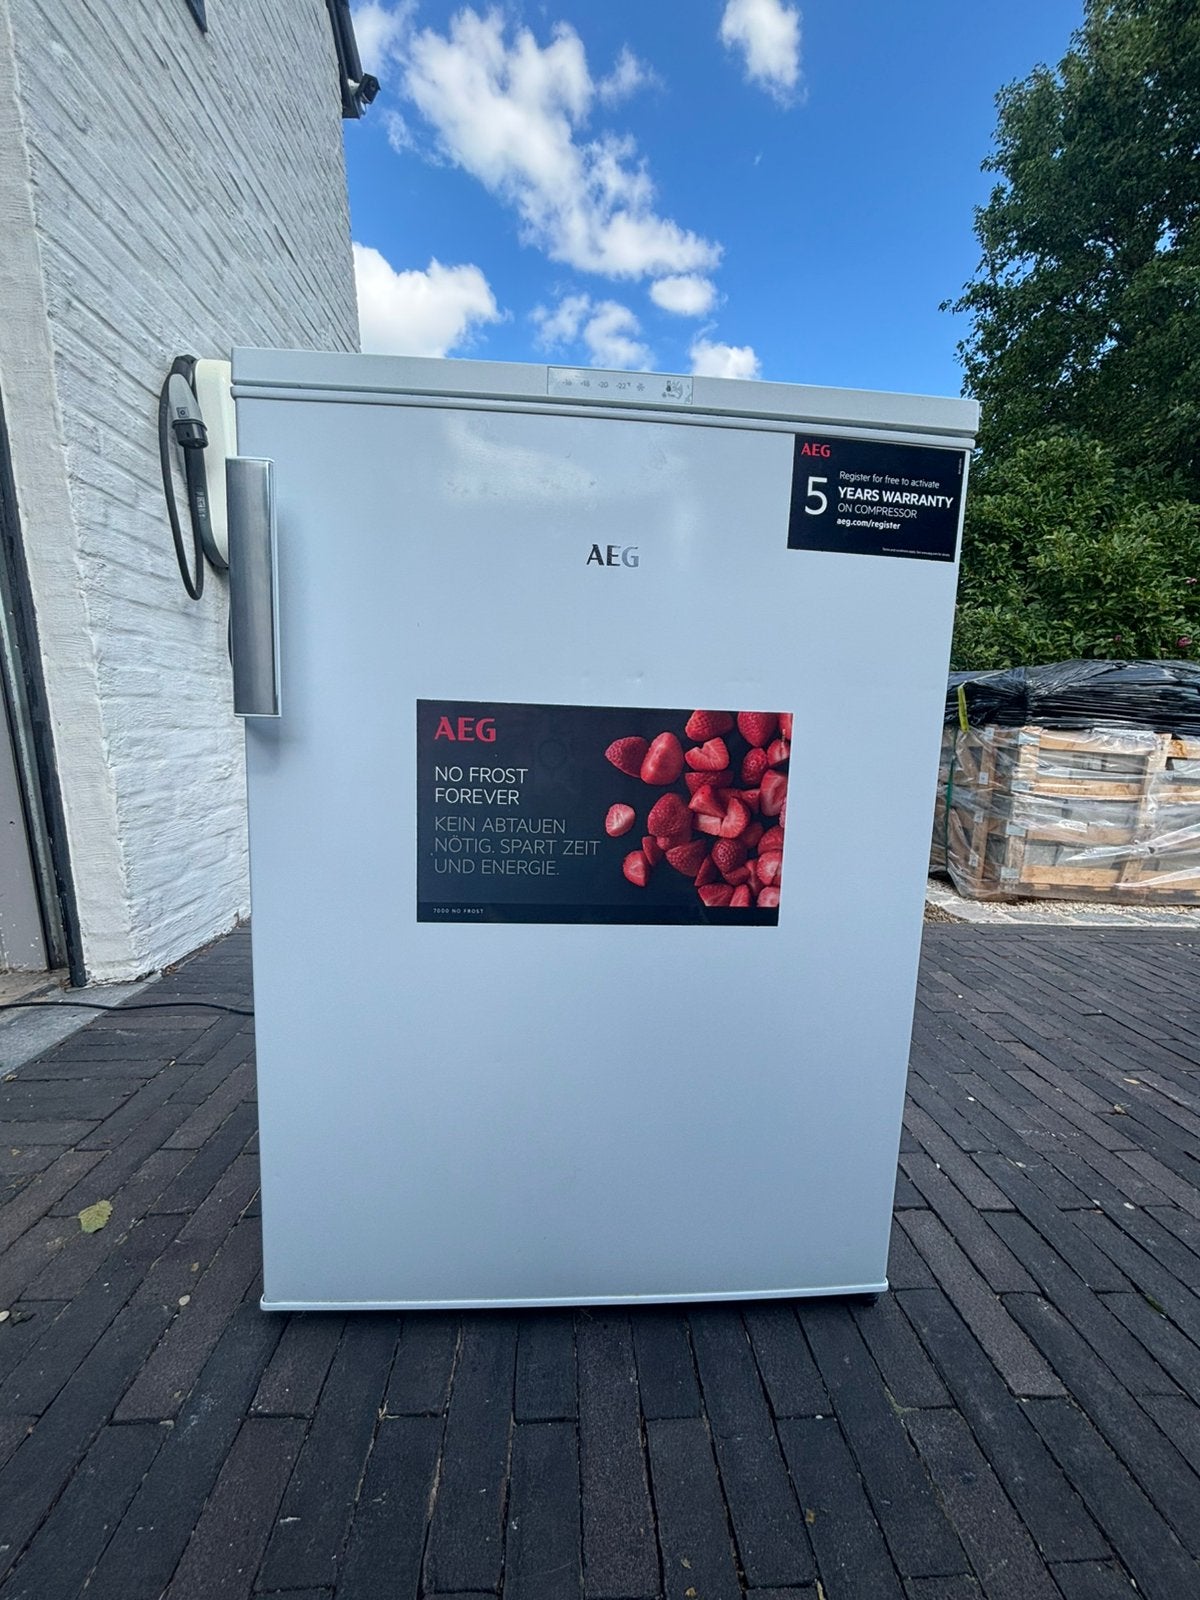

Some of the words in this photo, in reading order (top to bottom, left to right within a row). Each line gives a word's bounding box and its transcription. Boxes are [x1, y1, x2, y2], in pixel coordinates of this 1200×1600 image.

[801, 442, 832, 458] AEG
[840, 470, 870, 482] Register
[872, 473, 884, 483] for
[885, 475, 900, 485] free
[901, 478, 910, 486] to
[910, 479, 940, 489] activate
[804, 476, 828, 516] 5
[838, 486, 880, 502] YEARS
[882, 490, 954, 508] WARRANTY
[838, 502, 852, 513] ON
[854, 504, 918, 518] COMPRESSOR
[836, 518, 901, 530] aeg.com/register
[586, 544, 640, 568] AEG
[434, 716, 497, 742] AEG
[435, 766, 463, 782] NO
[469, 767, 529, 784] FROST
[435, 788, 520, 805] FOREVER
[435, 816, 476, 832] KEIN
[481, 818, 566, 834] ABTAUEN
[435, 834, 495, 853] NÖTIG.
[500, 838, 558, 854] SPART
[562, 840, 601, 856] ZEIT
[434, 859, 476, 874] UND
[481, 860, 560, 876] ENERGIE.
